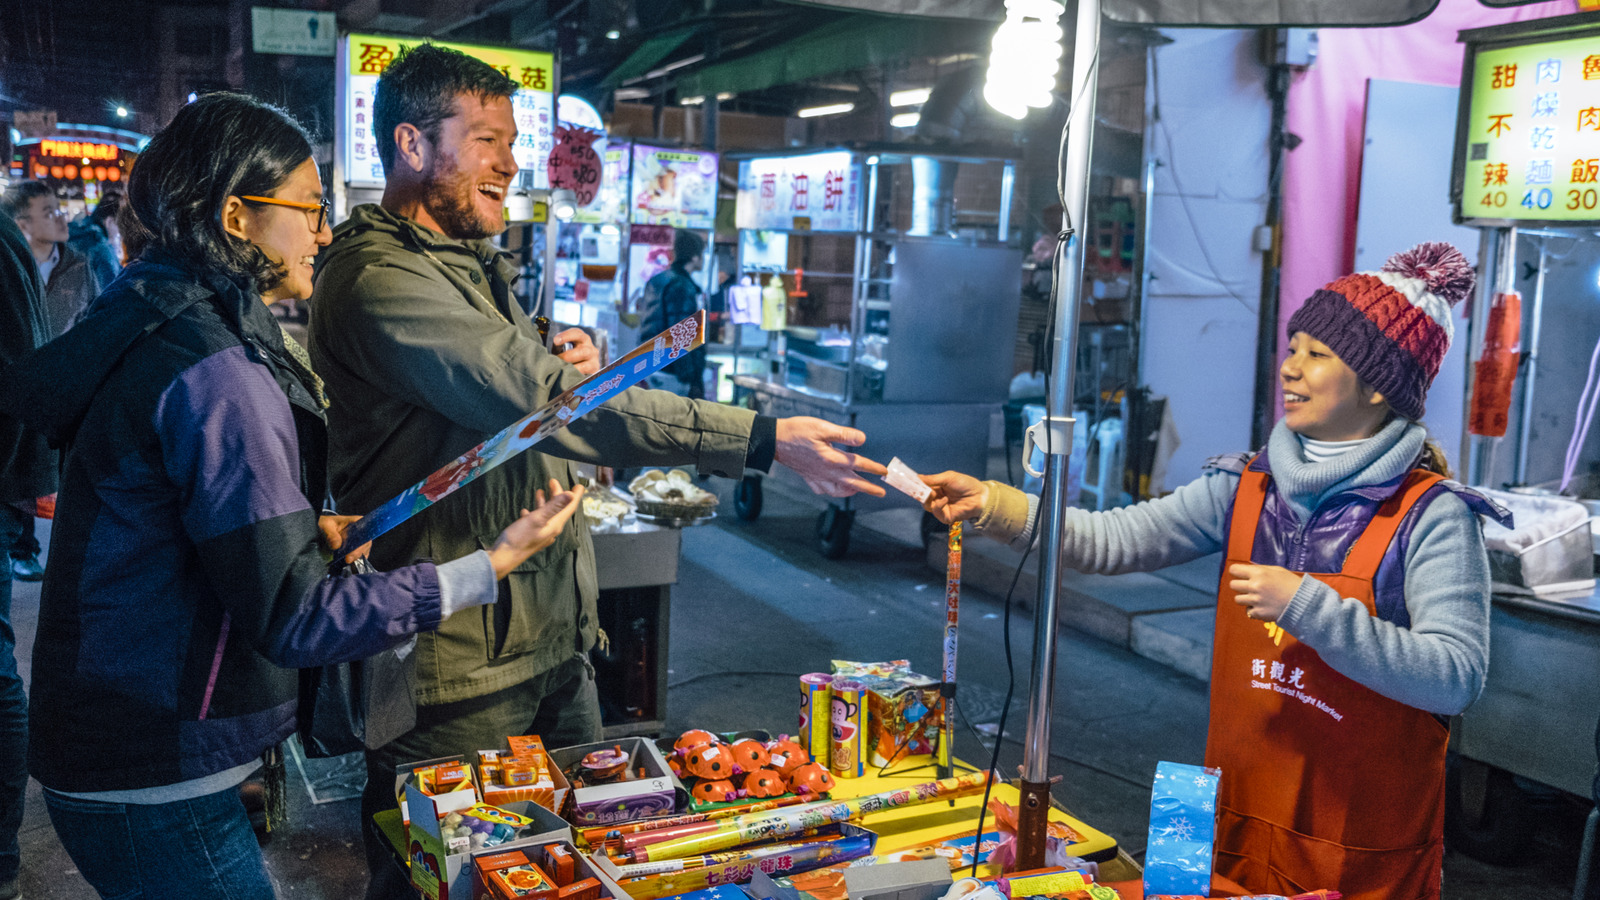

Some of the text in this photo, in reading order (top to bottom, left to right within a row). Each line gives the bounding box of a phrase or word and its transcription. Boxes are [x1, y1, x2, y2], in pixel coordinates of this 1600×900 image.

[1483, 62, 1518, 188] 甜不辣
[550, 153, 562, 173] 中
[1480, 191, 1508, 208] 40
[1521, 188, 1553, 210] 40
[1566, 188, 1598, 210] 30
[1251, 658, 1305, 690] 街觀光
[1251, 680, 1344, 722] Street Tourist Night Market
[704, 854, 794, 886] 七彩火龍珠
